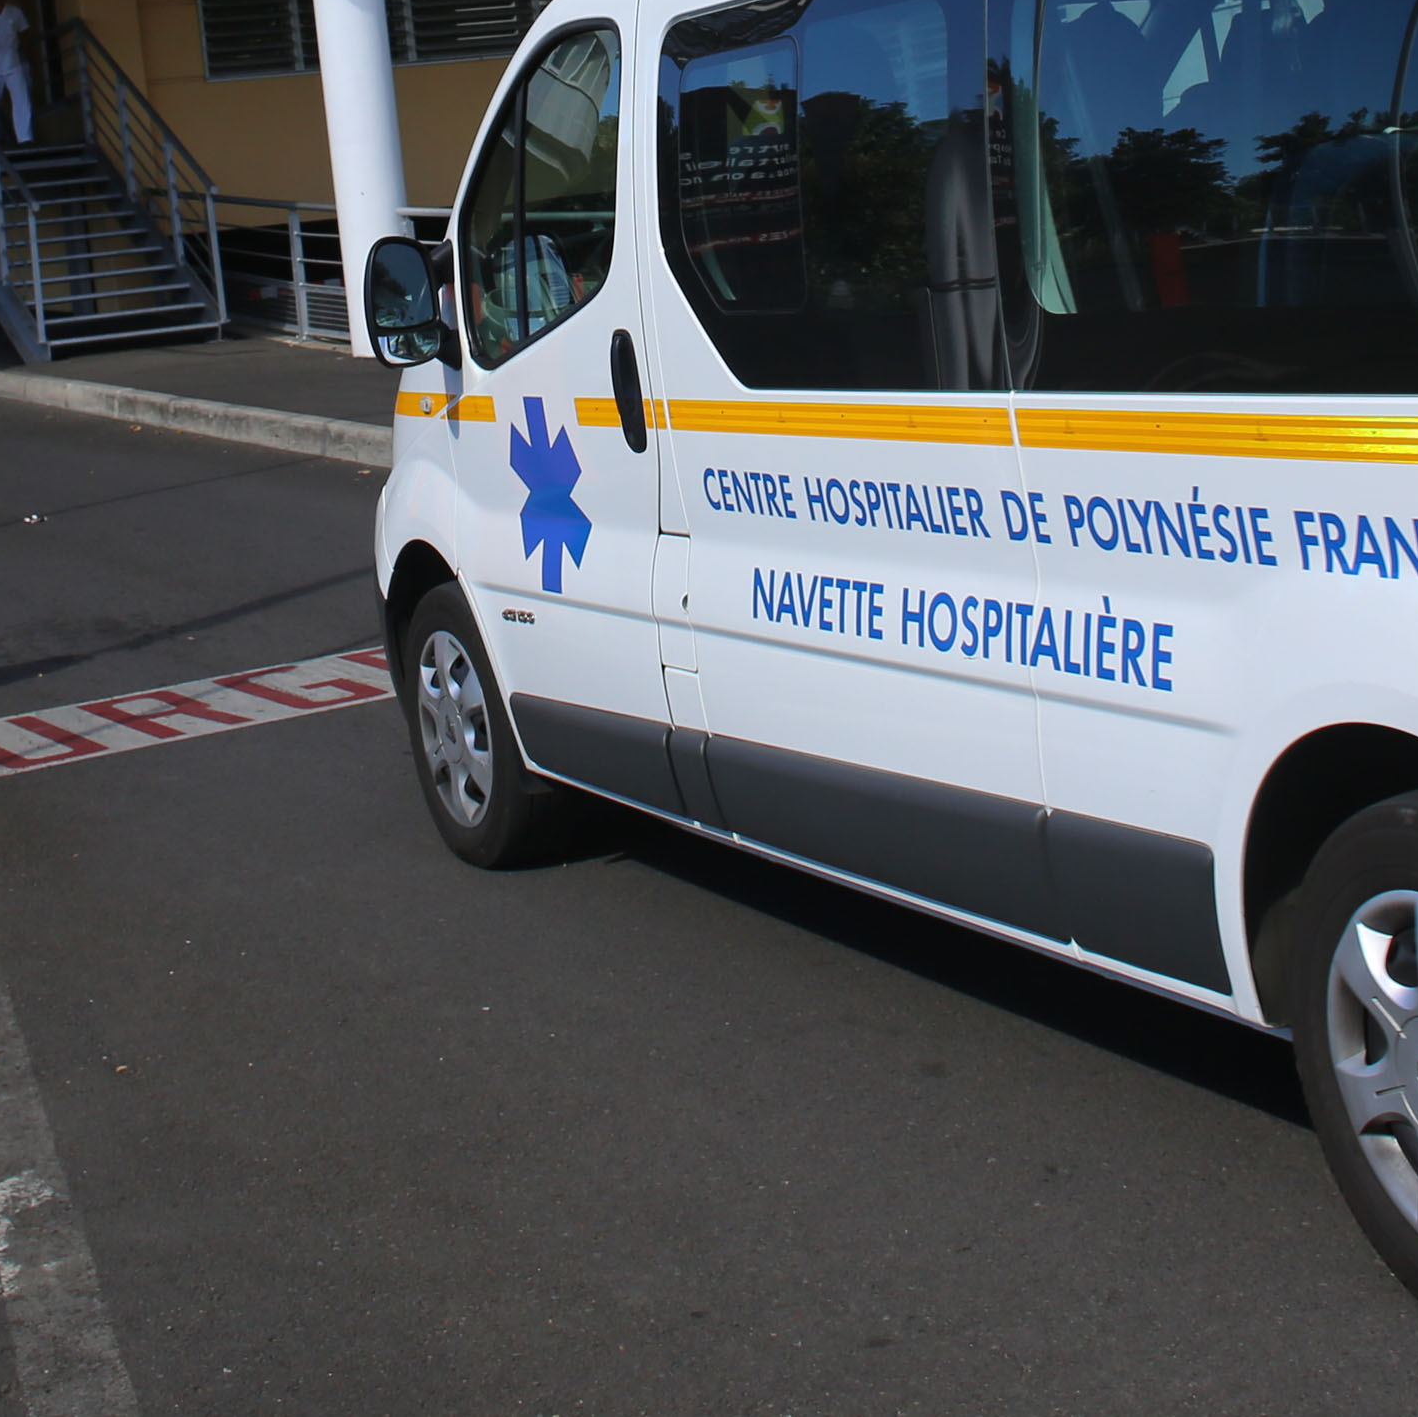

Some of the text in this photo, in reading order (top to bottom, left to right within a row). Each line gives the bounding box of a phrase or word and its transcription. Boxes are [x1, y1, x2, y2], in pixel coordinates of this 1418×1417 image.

[703, 467, 797, 519] CENTRE
[808, 476, 991, 539] HOSPITALIER
[999, 489, 1052, 545] DE
[1063, 486, 1278, 567] POLYNÉSIE
[752, 566, 1174, 692] NAVETTE HOSPITALIÈRE
